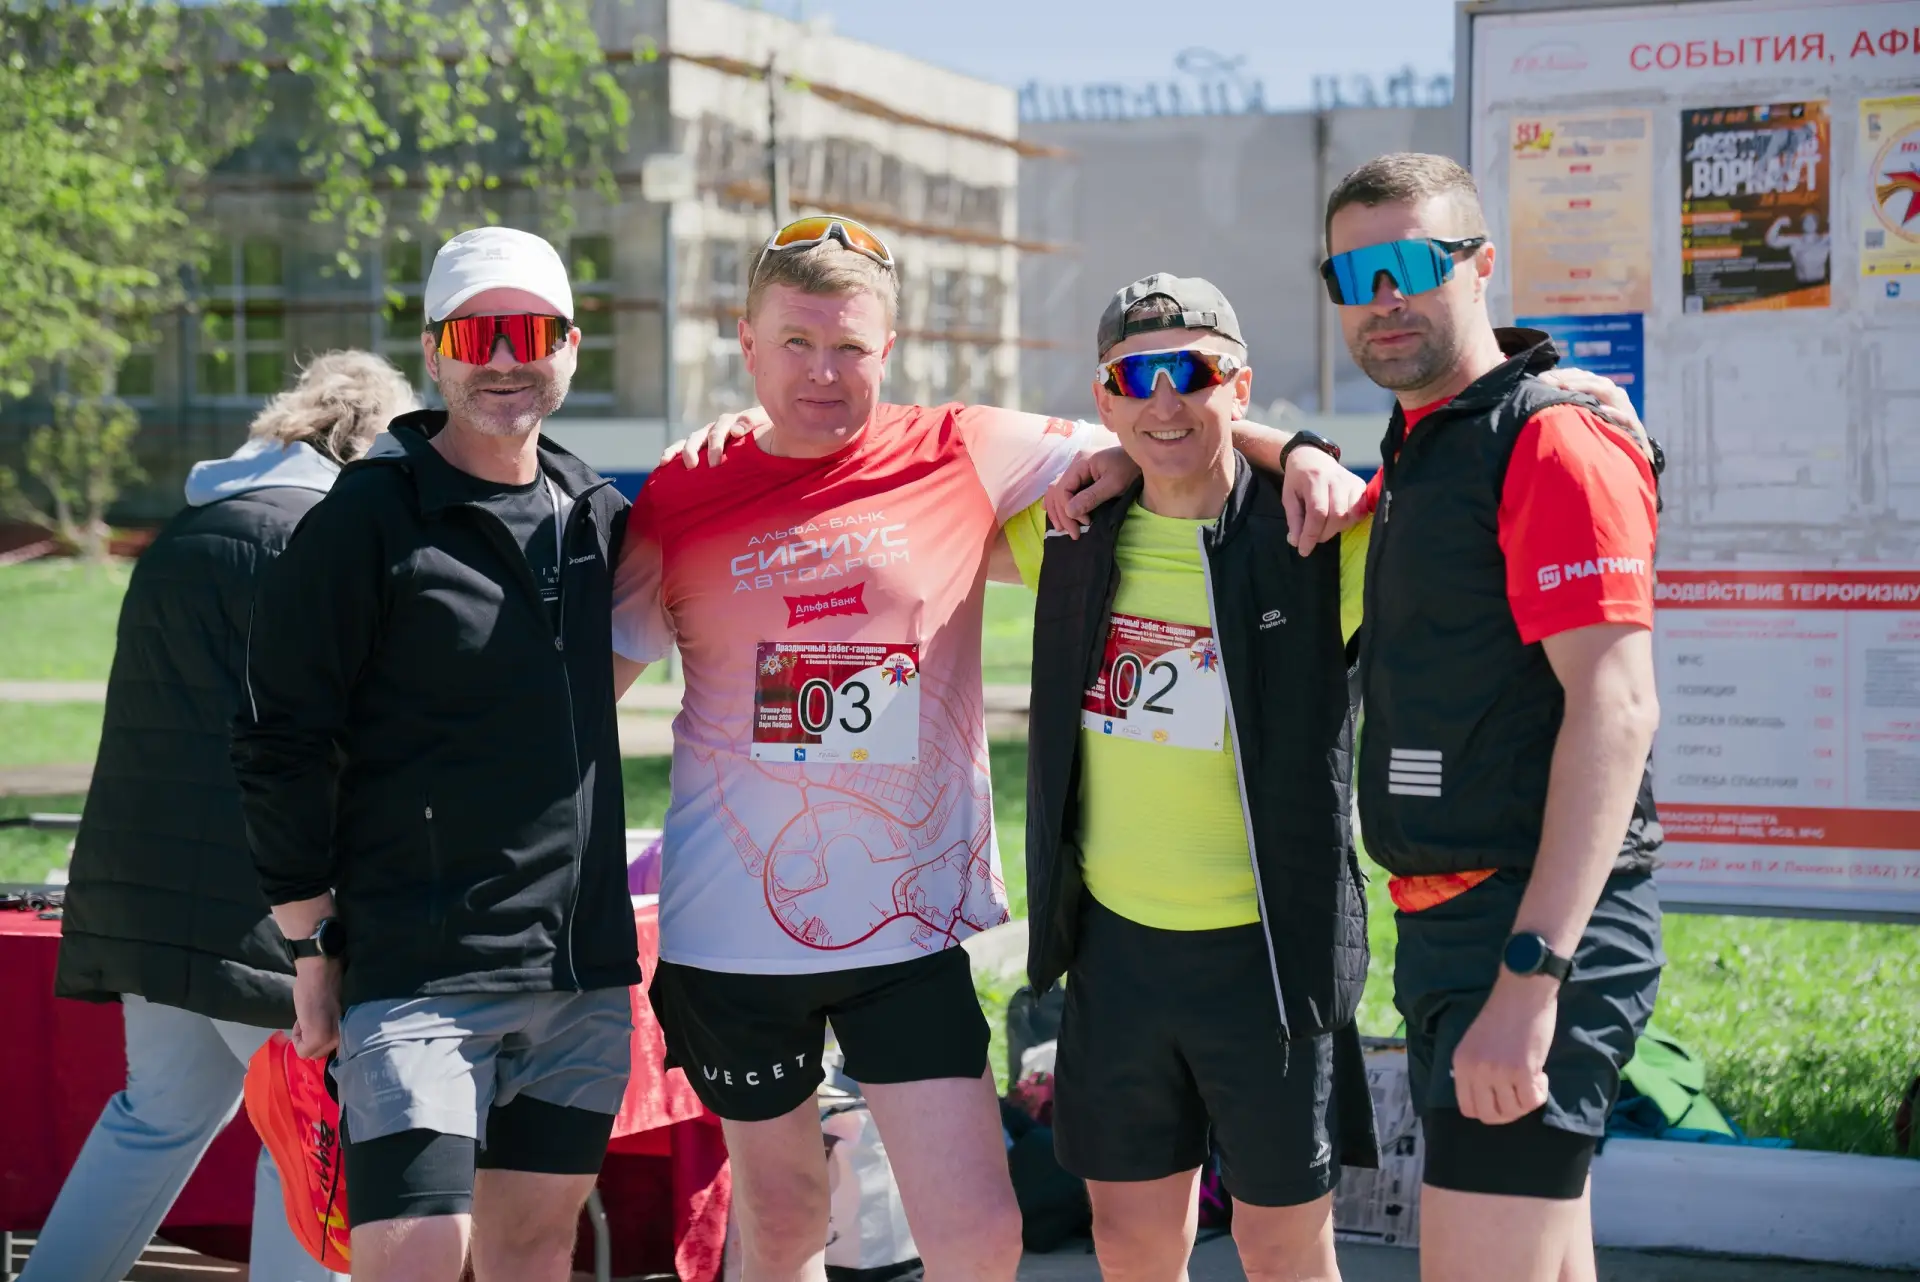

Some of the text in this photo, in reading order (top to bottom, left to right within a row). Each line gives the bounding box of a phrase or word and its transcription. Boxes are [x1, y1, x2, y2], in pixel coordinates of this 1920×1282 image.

[1630, 33, 1835, 71] СОБЫТИЯ,
[748, 510, 887, 547] АЛЬФА-БАНК
[730, 523, 909, 577] СИРИУС
[733, 550, 910, 595] АВТОДРОМ
[1563, 557, 1645, 581] МАГНИТ
[795, 595, 857, 616] Альфа Банк
[1789, 582, 1920, 602] ТЕРРОРИЗМУ
[776, 643, 887, 655] Праздничный забег-гандикап
[1110, 652, 1178, 715] 02
[798, 678, 872, 734] 03
